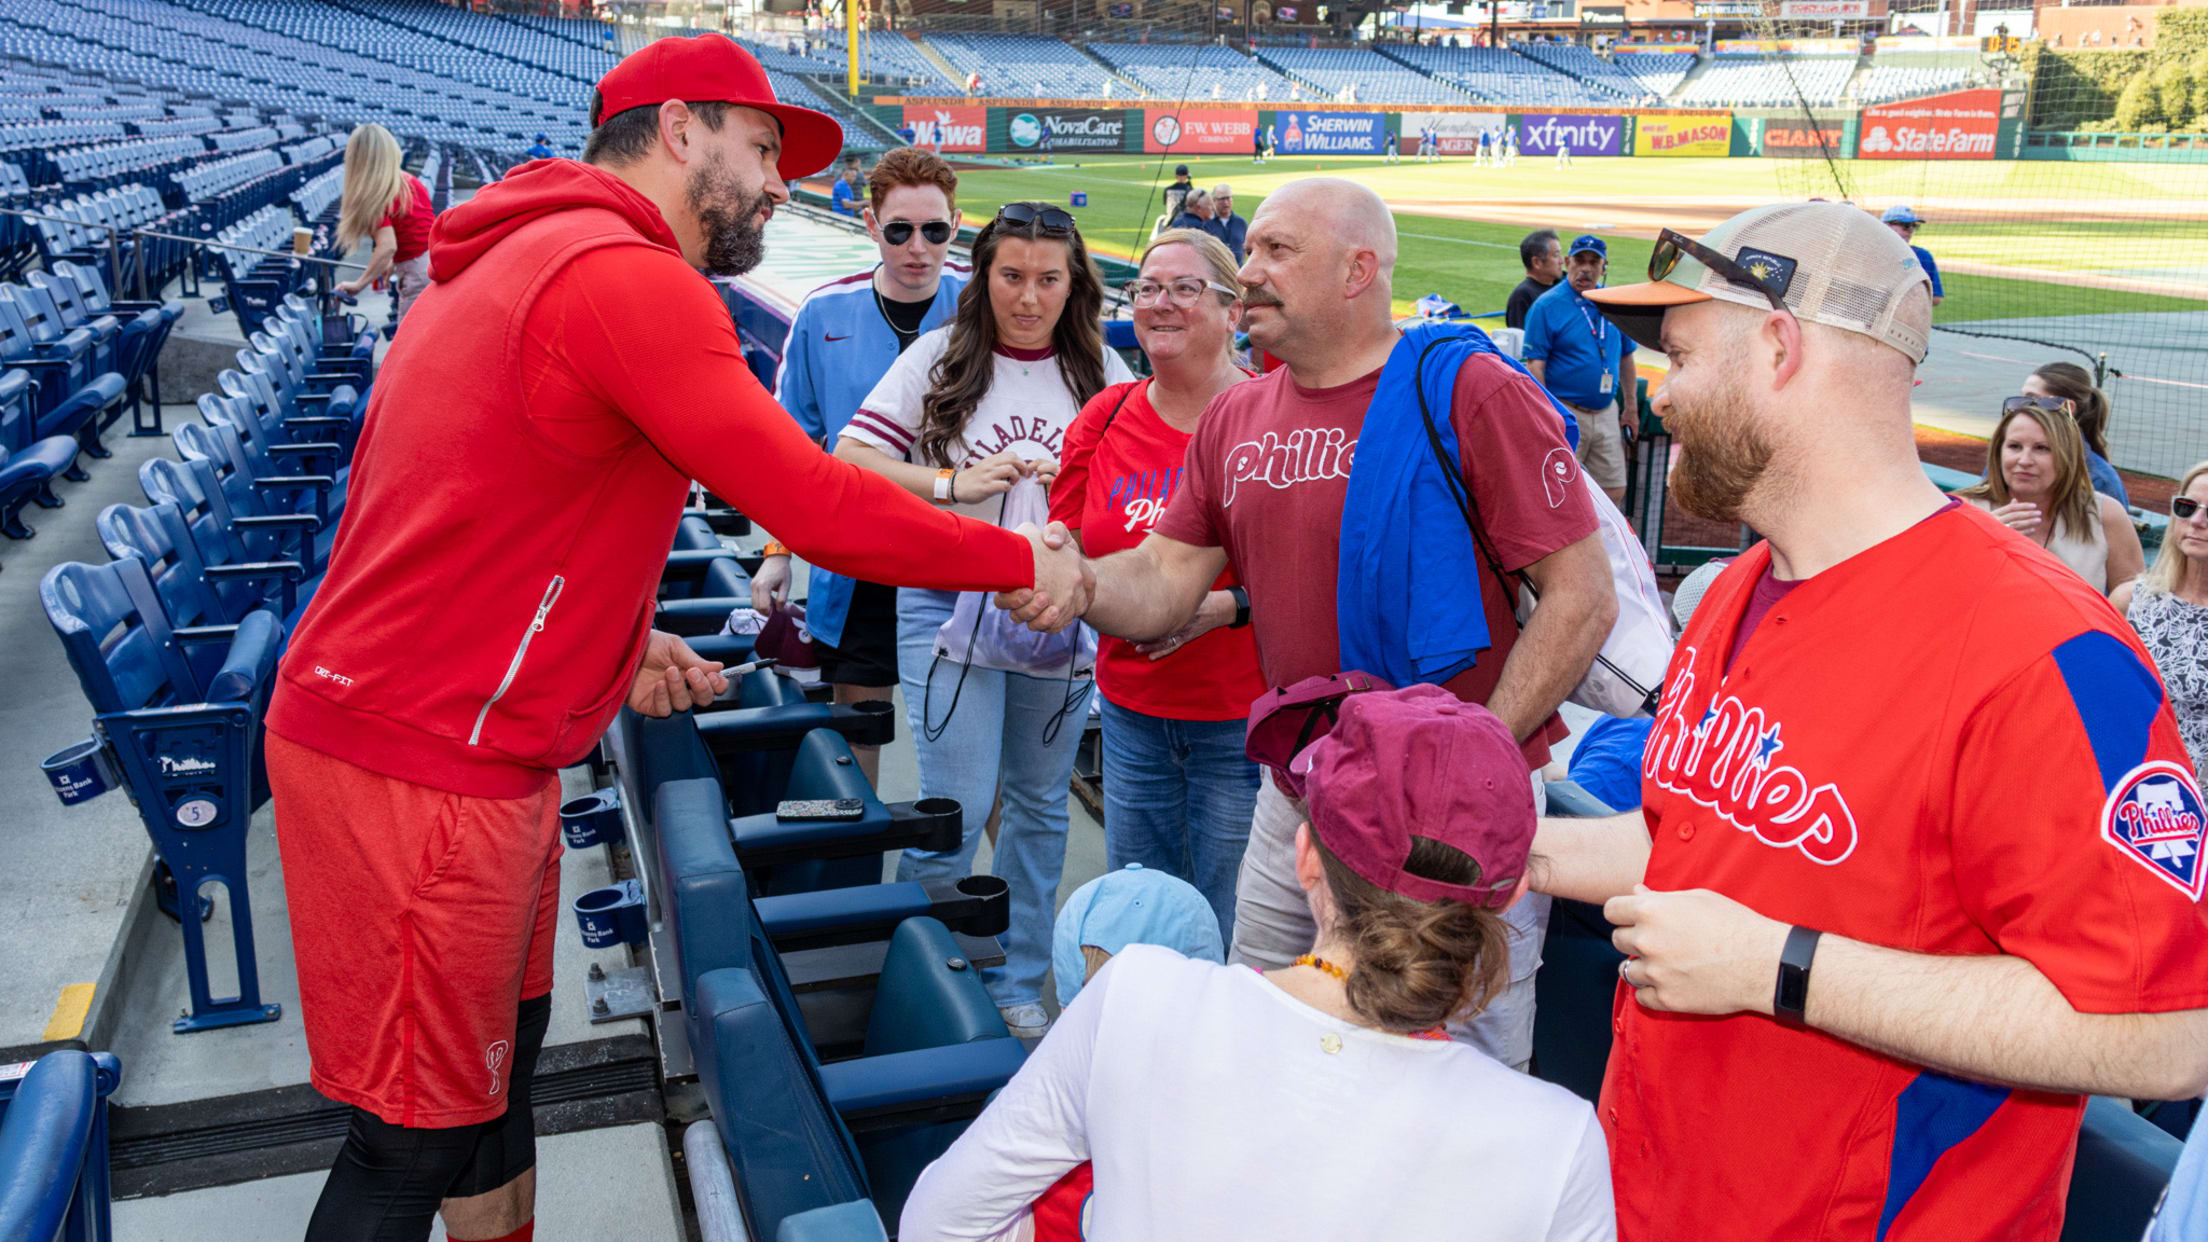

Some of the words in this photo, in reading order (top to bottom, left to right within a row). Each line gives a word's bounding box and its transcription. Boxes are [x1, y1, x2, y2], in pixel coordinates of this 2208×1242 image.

[1045, 115, 1123, 135] NovaCare
[1212, 122, 1250, 136] WEBB
[1305, 115, 1374, 132] SHERWIN
[1525, 117, 1616, 151] xfinity
[1764, 128, 1843, 148] GIANT
[314, 665, 354, 687] DRI-FIT
[72, 778, 93, 789] Bank
[191, 806, 200, 821] 5
[2119, 800, 2201, 840] Phillies
